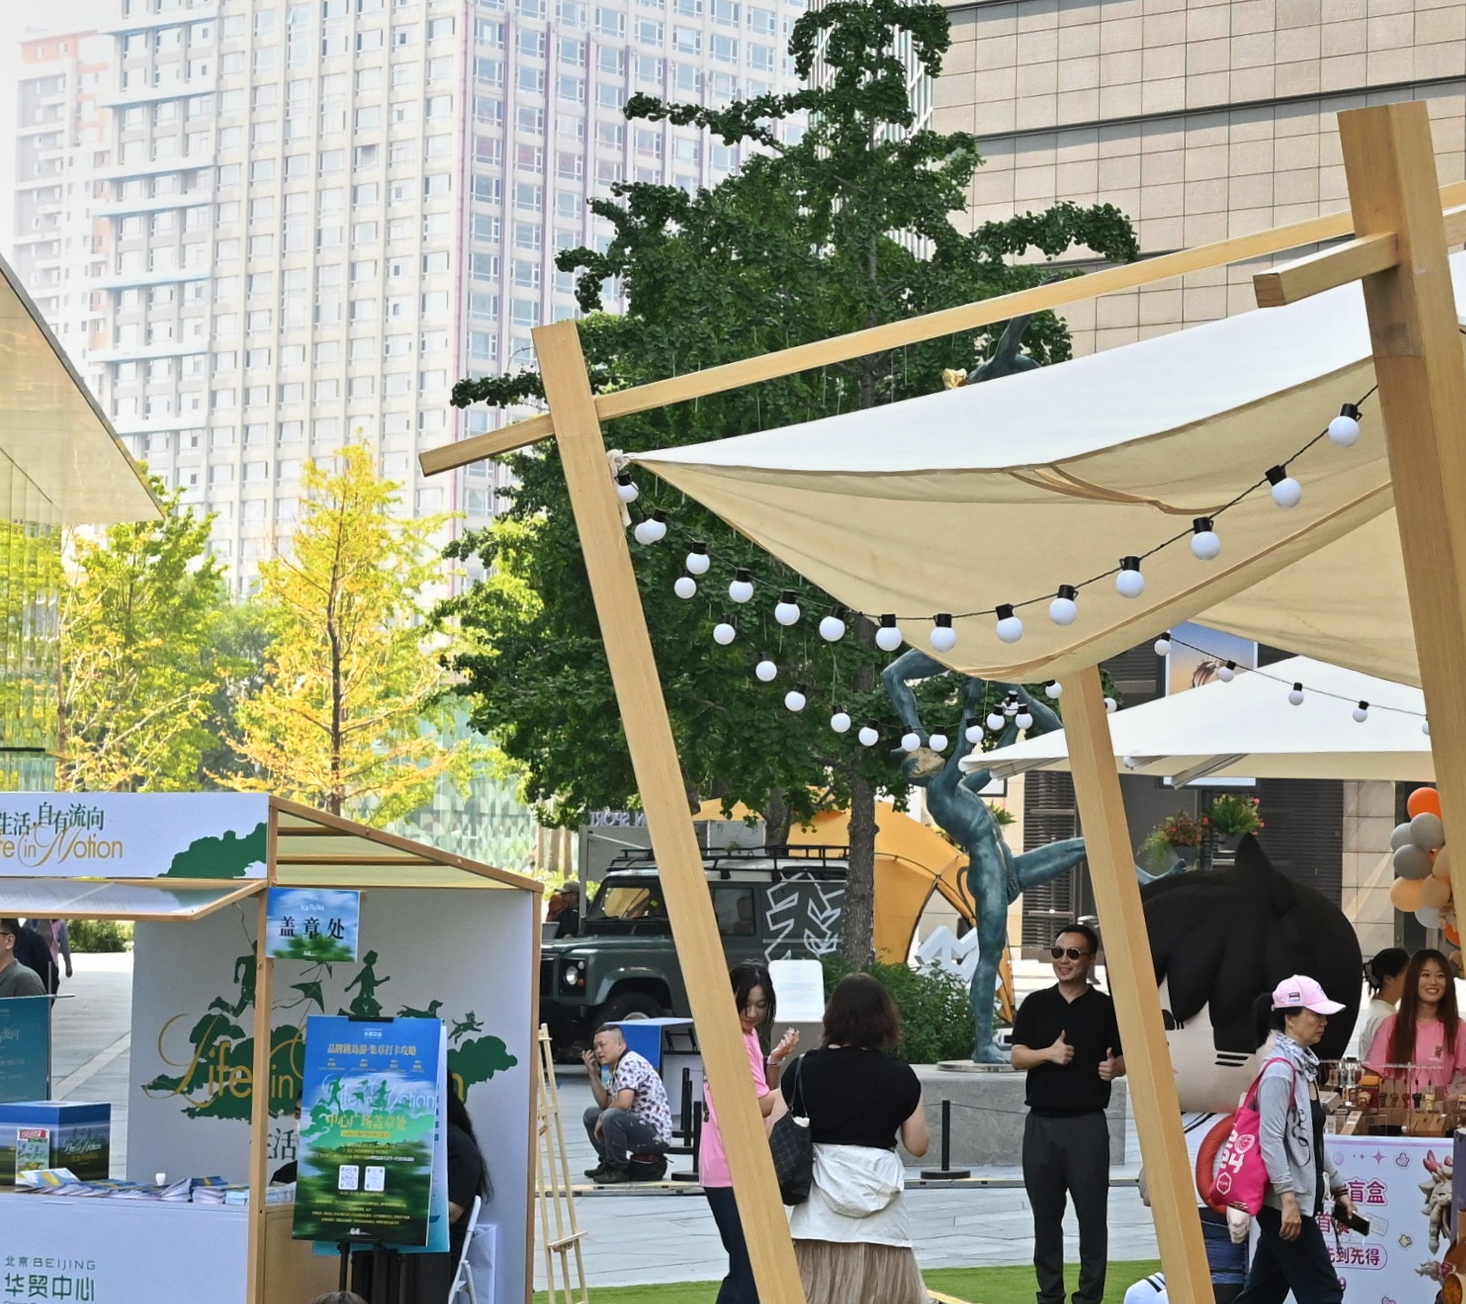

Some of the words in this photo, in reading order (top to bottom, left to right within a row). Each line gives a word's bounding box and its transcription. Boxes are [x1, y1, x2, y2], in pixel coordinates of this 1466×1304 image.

[18, 820, 124, 867] Motion
[280, 915, 345, 940] 盖章处
[1348, 1179, 1386, 1205] 盲盒
[5, 1255, 29, 1267] 北京
[33, 1257, 96, 1271] BEIJING
[5, 1272, 95, 1302] 华贸中心
